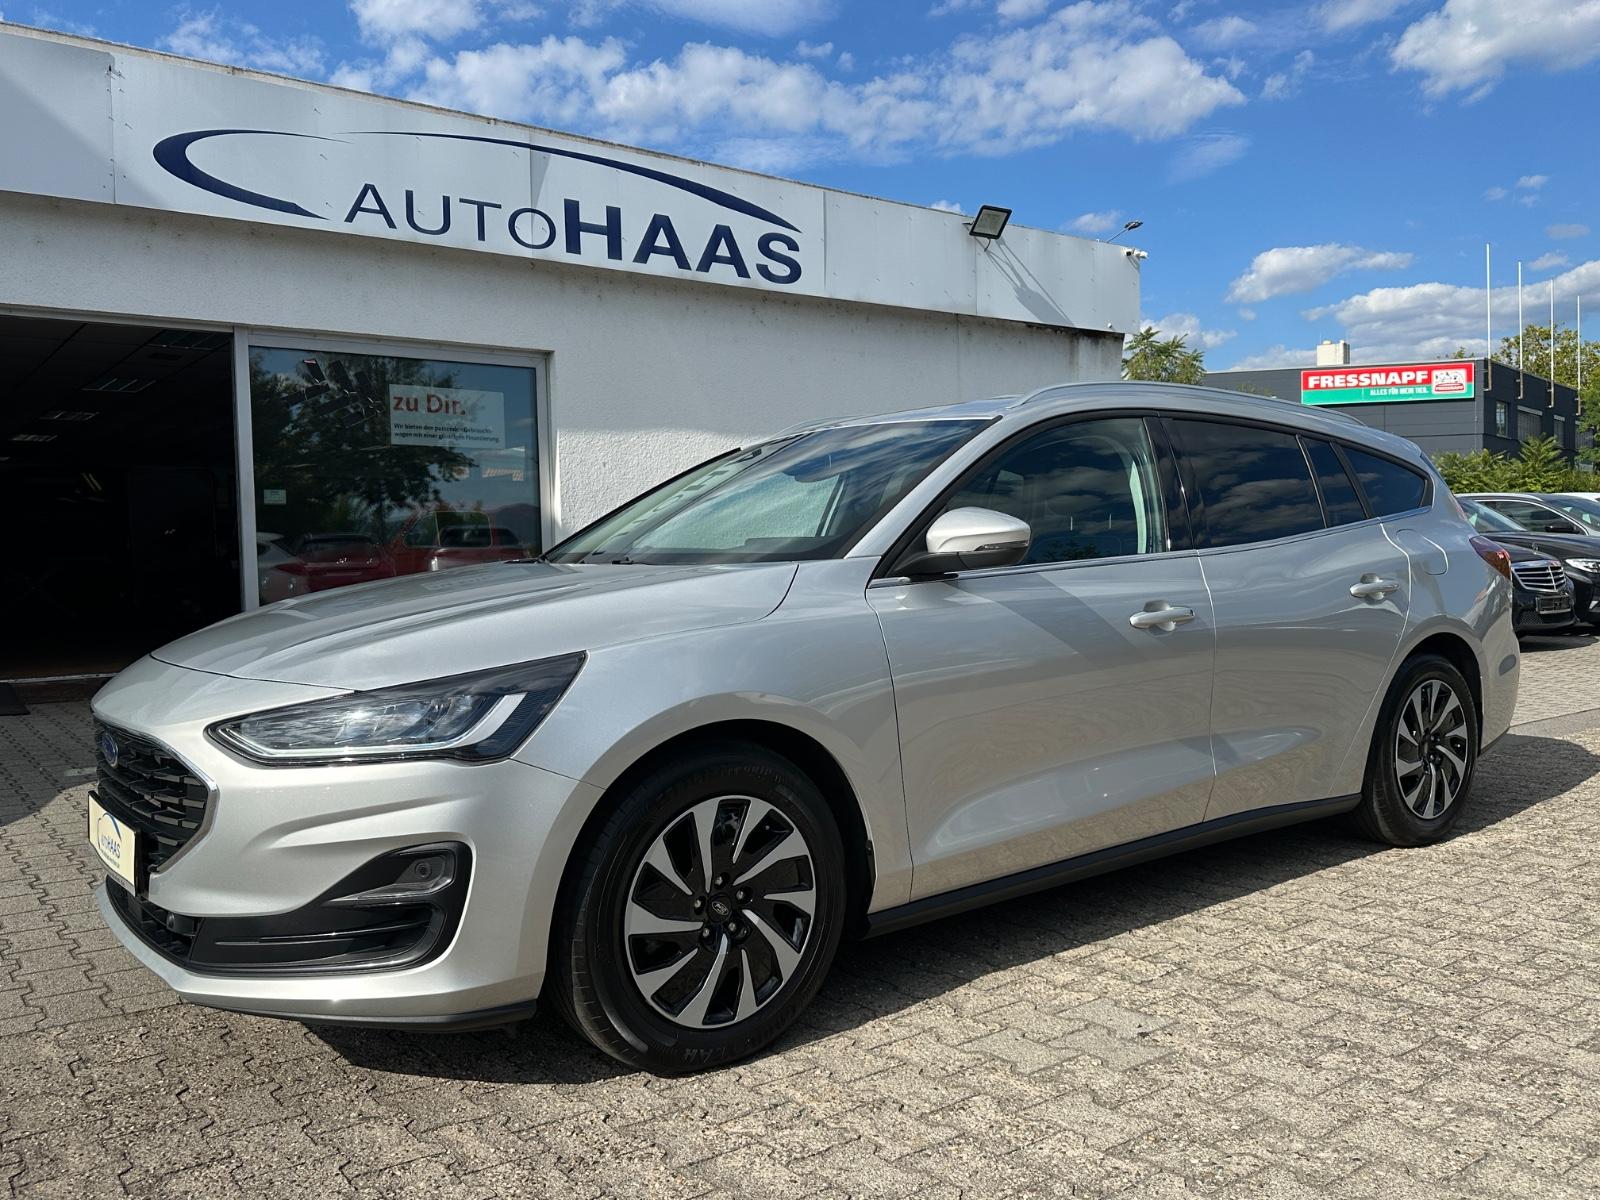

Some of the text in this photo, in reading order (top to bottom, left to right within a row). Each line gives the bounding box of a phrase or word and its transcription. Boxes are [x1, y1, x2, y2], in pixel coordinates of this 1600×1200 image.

[1307, 370, 1428, 388] FRESSNAPF
[1370, 387, 1387, 396] ALLES
[1388, 386, 1399, 396] FÜR
[1399, 386, 1414, 395] MEIN
[392, 392, 466, 415] zu Dir.
